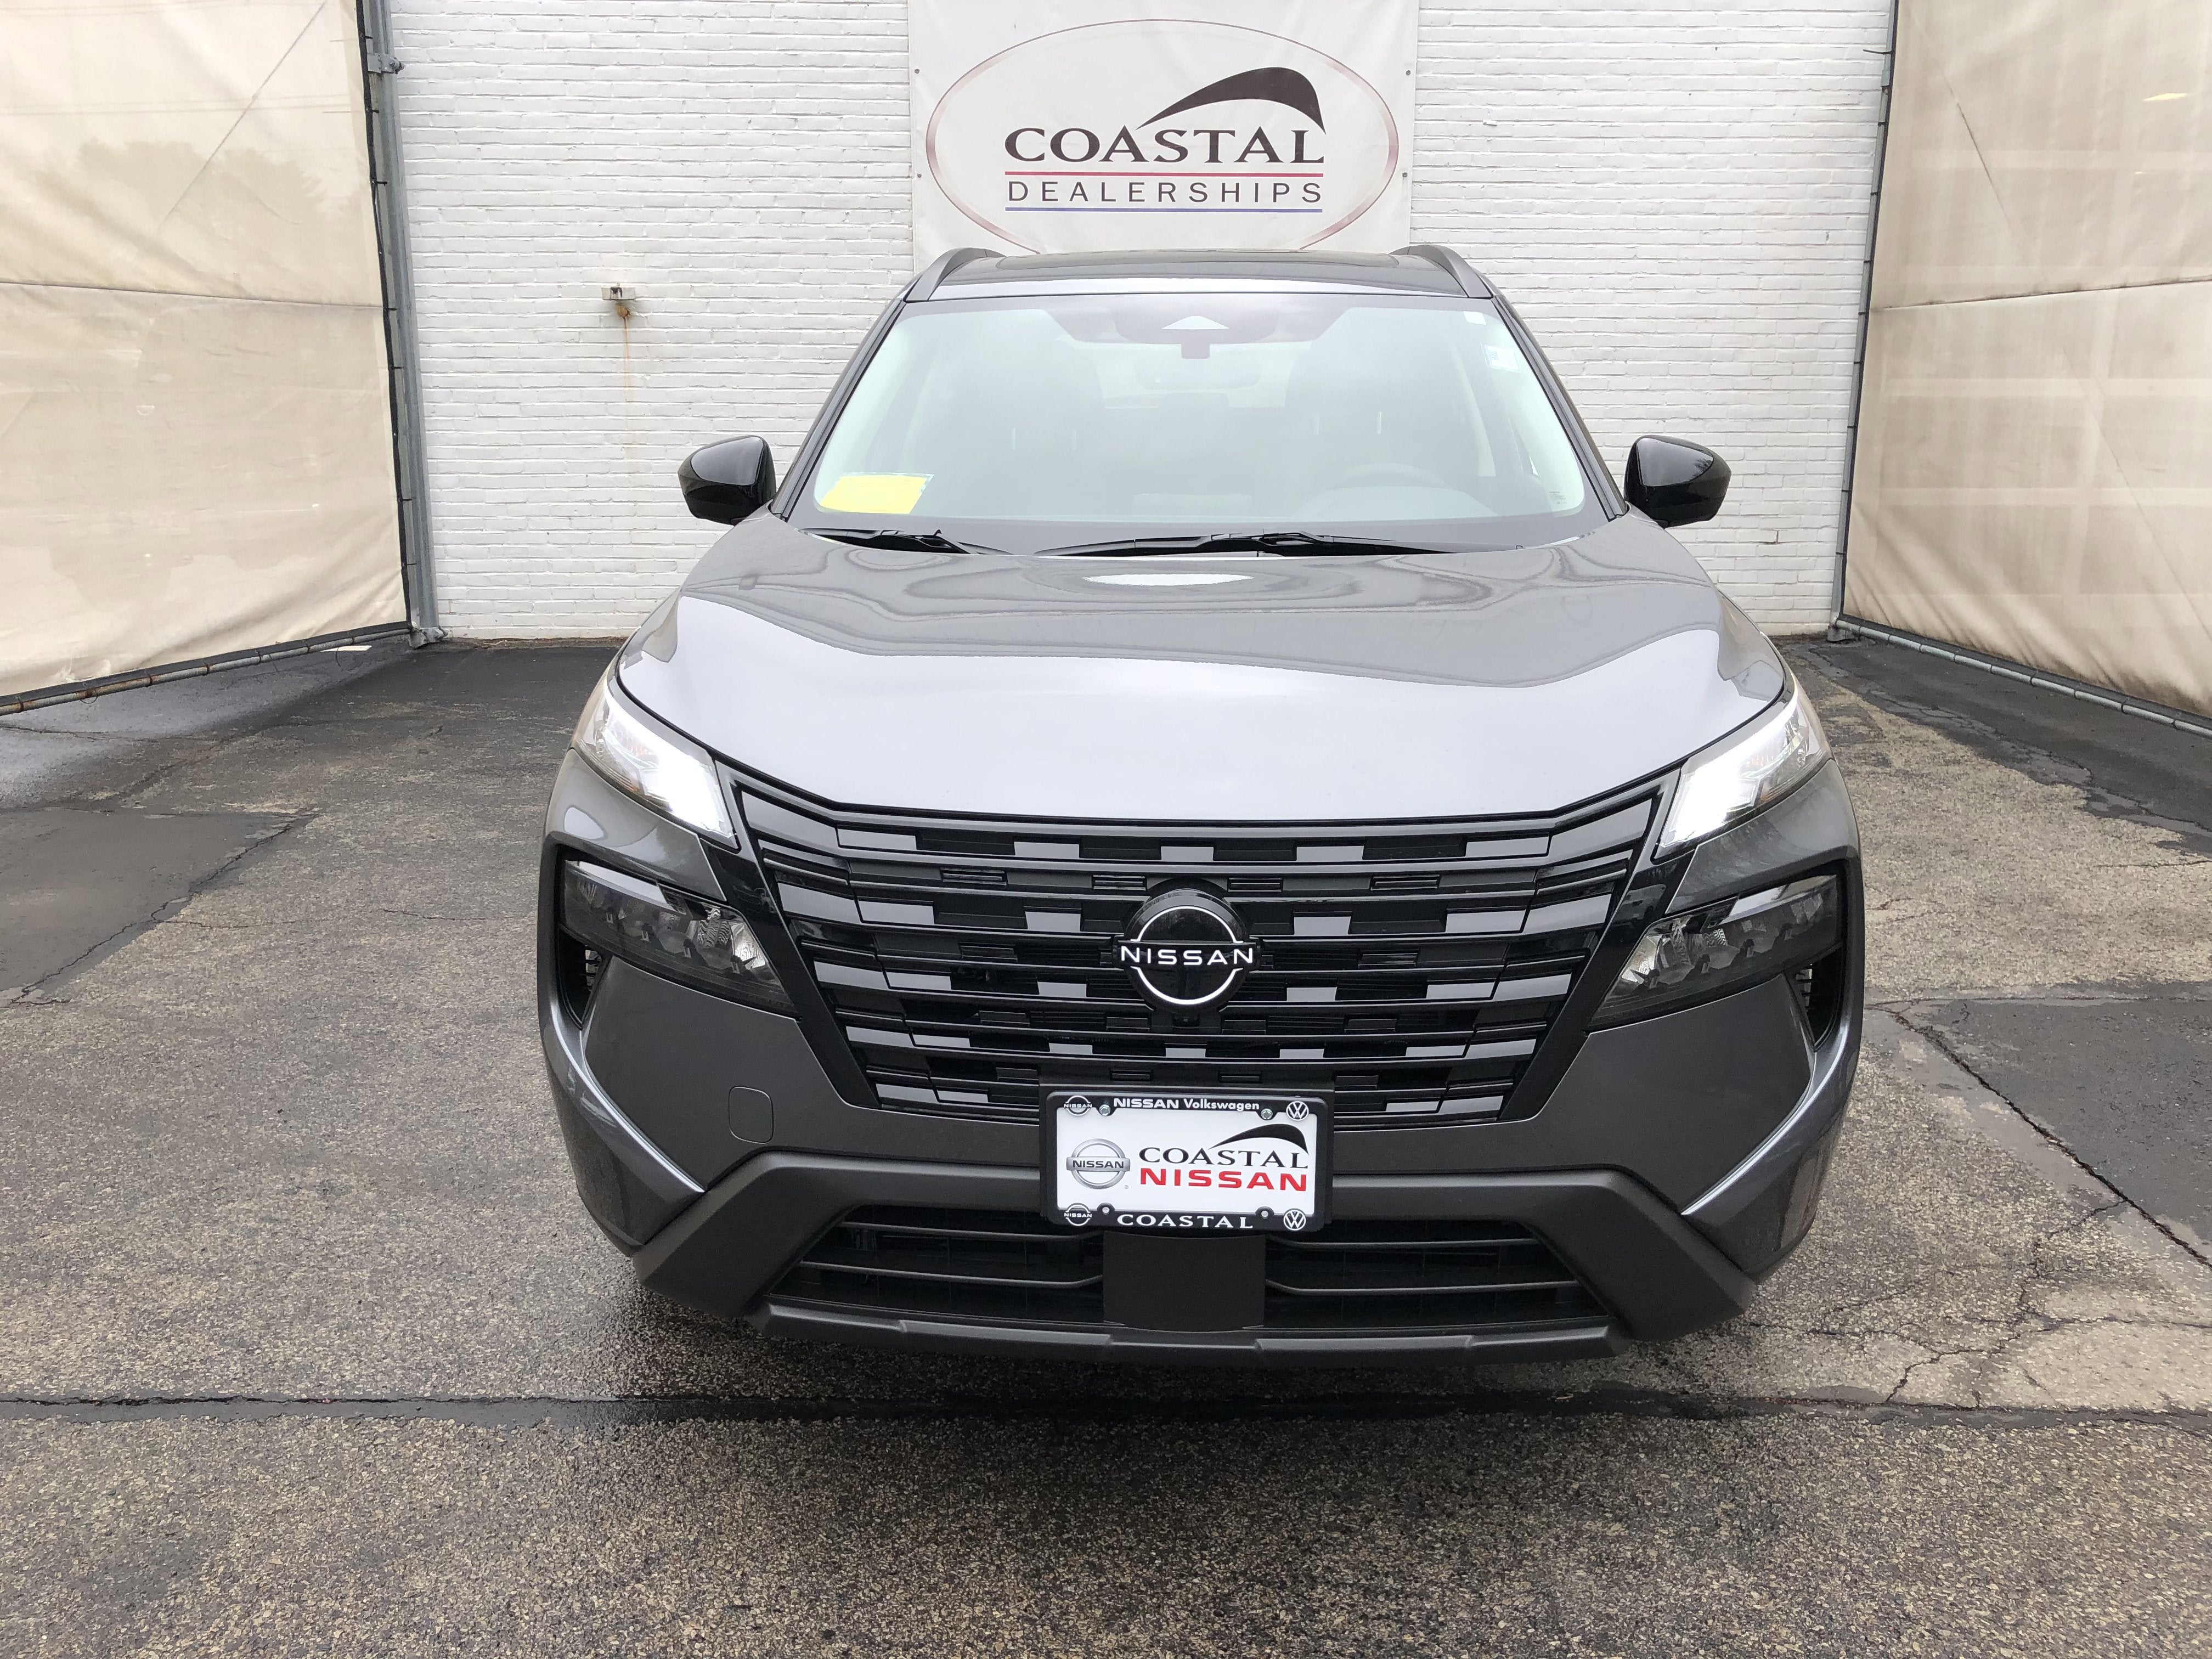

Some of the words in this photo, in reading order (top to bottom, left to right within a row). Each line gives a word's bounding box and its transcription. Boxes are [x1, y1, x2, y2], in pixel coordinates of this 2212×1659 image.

[1005, 125, 1324, 164] COASTAL
[1008, 181, 1322, 204] DEALERSHIPS
[1121, 945, 1253, 966] NISSAN
[1114, 1098, 1179, 1109] NISSAN
[1184, 1098, 1260, 1111] Volkswagen
[1073, 1160, 1124, 1169] NISSAN
[1139, 1147, 1309, 1169] COASTAL
[1140, 1168, 1307, 1192] NISSAN
[1117, 1214, 1254, 1229] COASTAL
